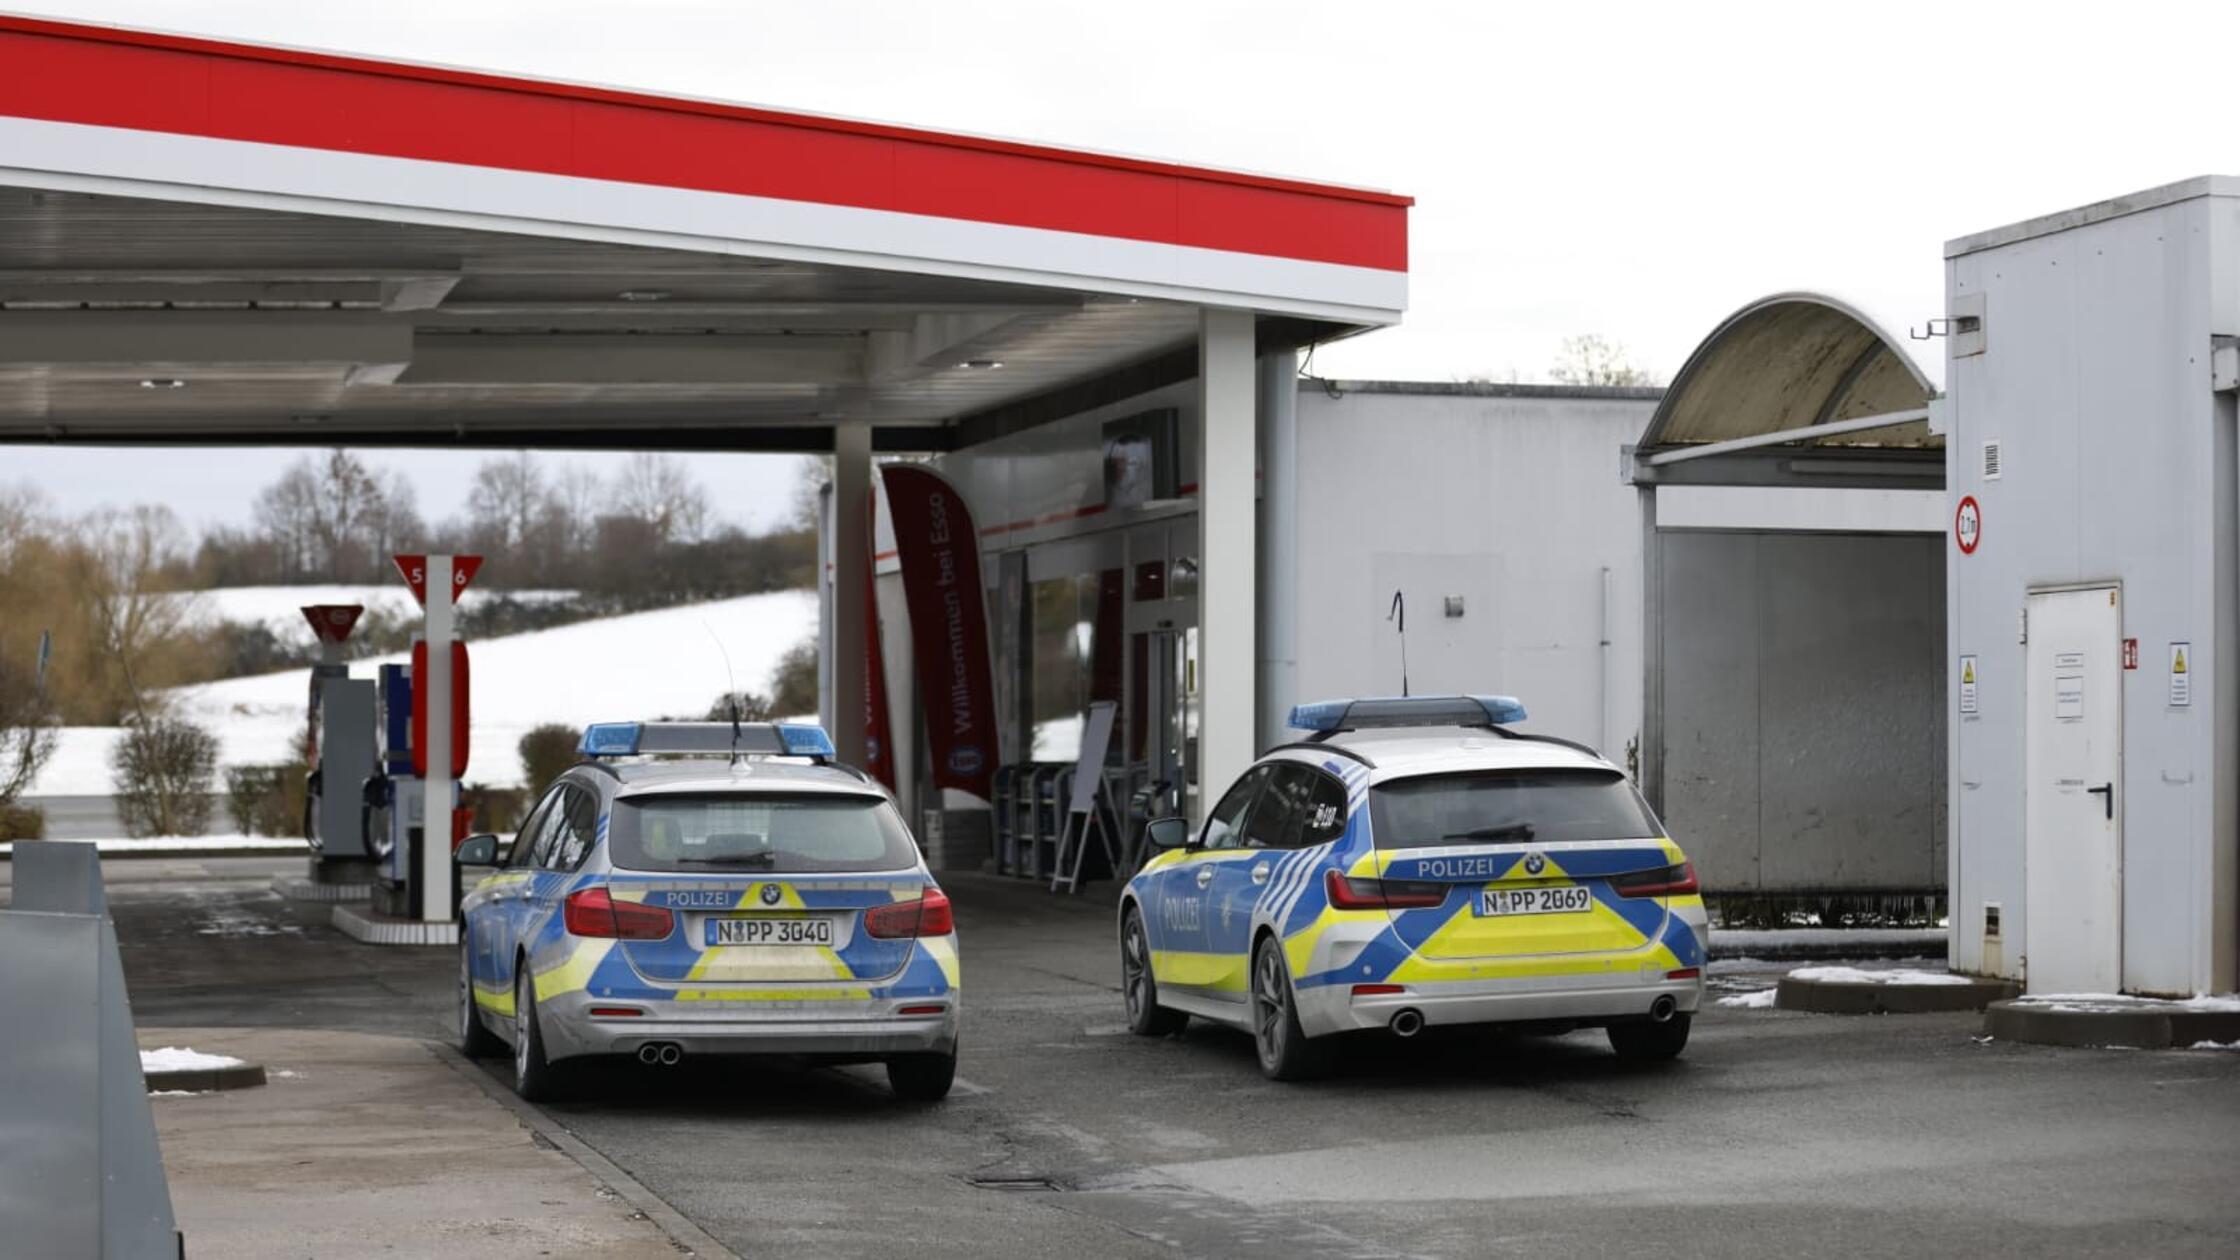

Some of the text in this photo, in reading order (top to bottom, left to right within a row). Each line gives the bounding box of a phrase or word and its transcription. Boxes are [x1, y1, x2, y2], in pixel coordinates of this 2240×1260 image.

[929, 492, 950, 545] Esso
[412, 568, 422, 583] 5
[455, 569, 466, 584] 6
[933, 549, 956, 588] bei
[943, 591, 974, 735] Willkommen
[1418, 858, 1493, 877] POLIZEI
[667, 892, 729, 905] POLIZEI
[1484, 889, 1588, 912] N PP 2069
[1165, 897, 1200, 931] POLIZEI
[718, 921, 829, 941] N PP 3040
